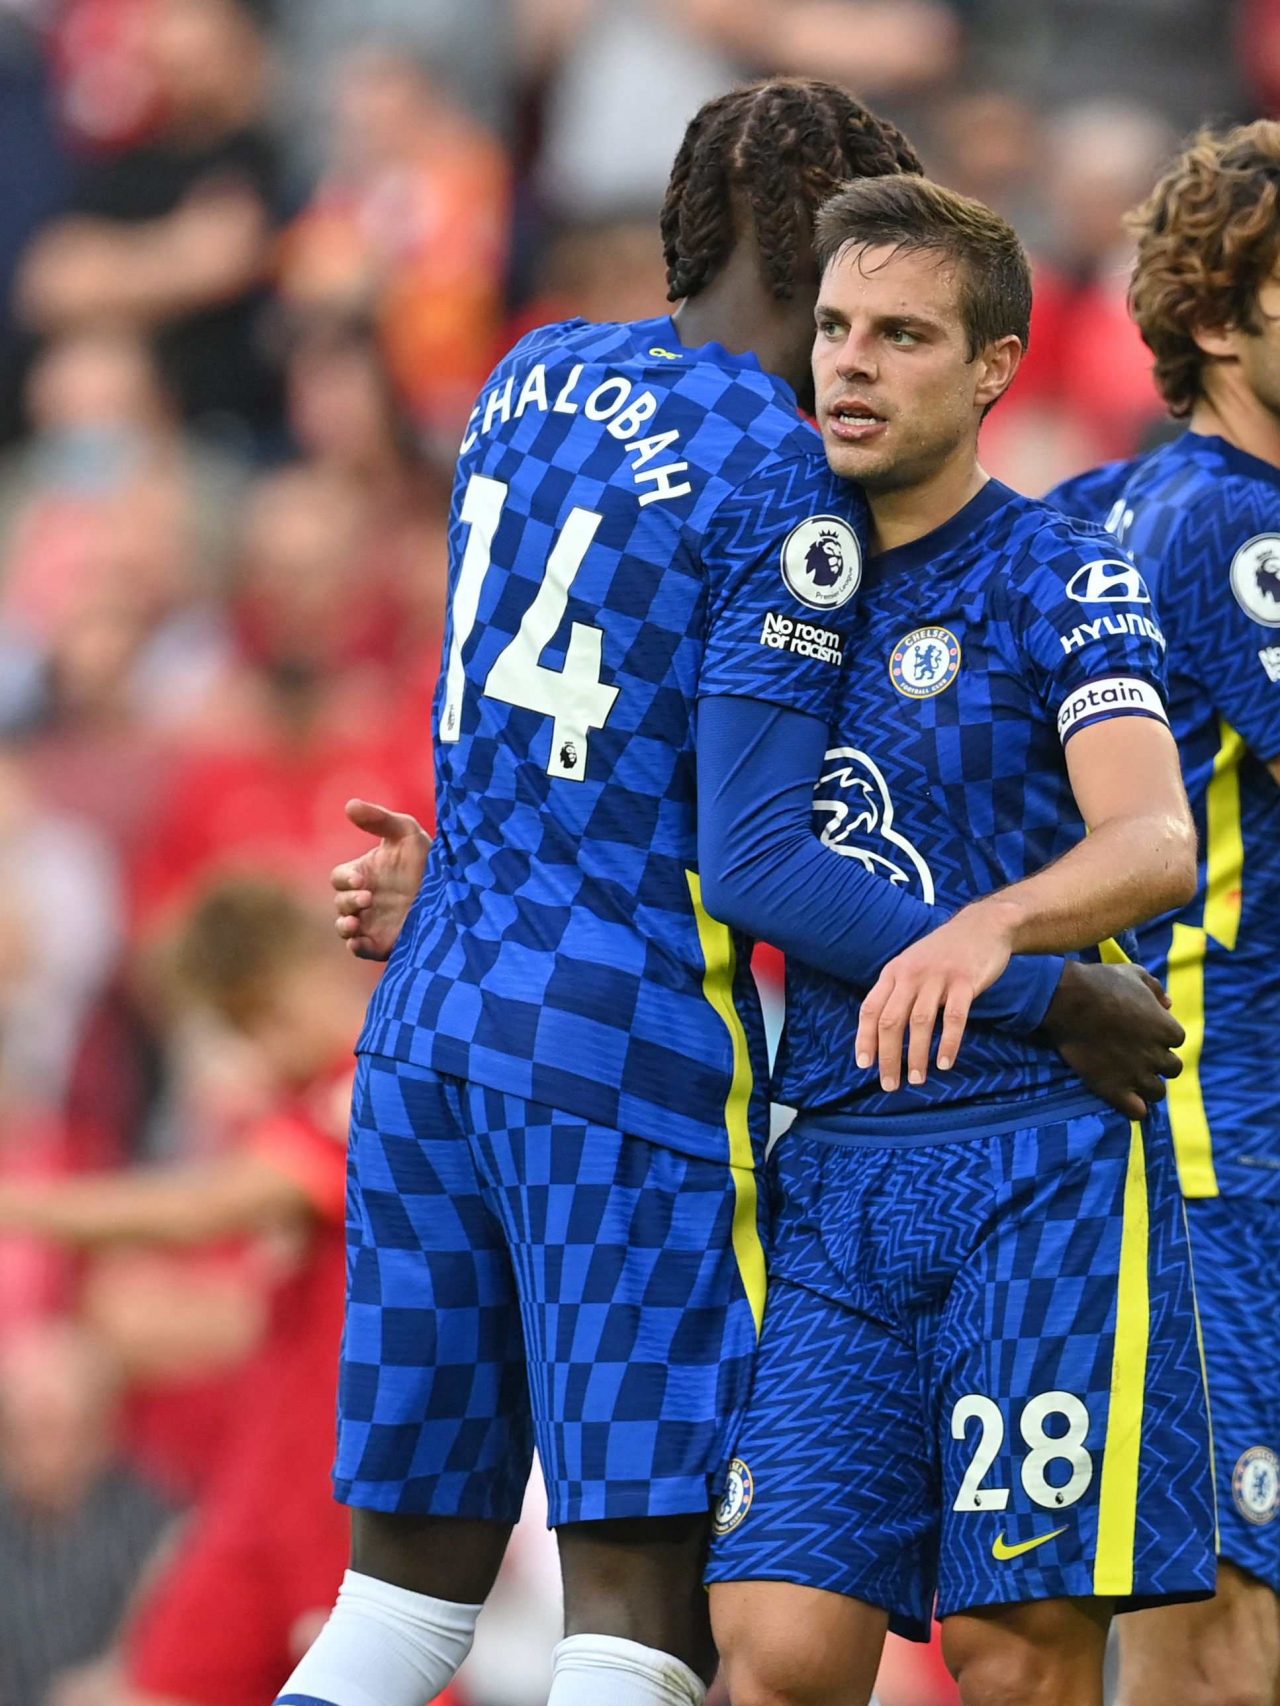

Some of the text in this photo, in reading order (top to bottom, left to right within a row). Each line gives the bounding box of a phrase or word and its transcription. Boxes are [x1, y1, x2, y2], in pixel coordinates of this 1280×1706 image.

[460, 363, 692, 507] CHALOBAH
[815, 566, 853, 600] Premier League
[440, 473, 621, 782] 14
[763, 612, 840, 648] No room
[904, 629, 950, 647] CHELSEA
[760, 629, 843, 666] for racism
[951, 1390, 1094, 1513] 28
